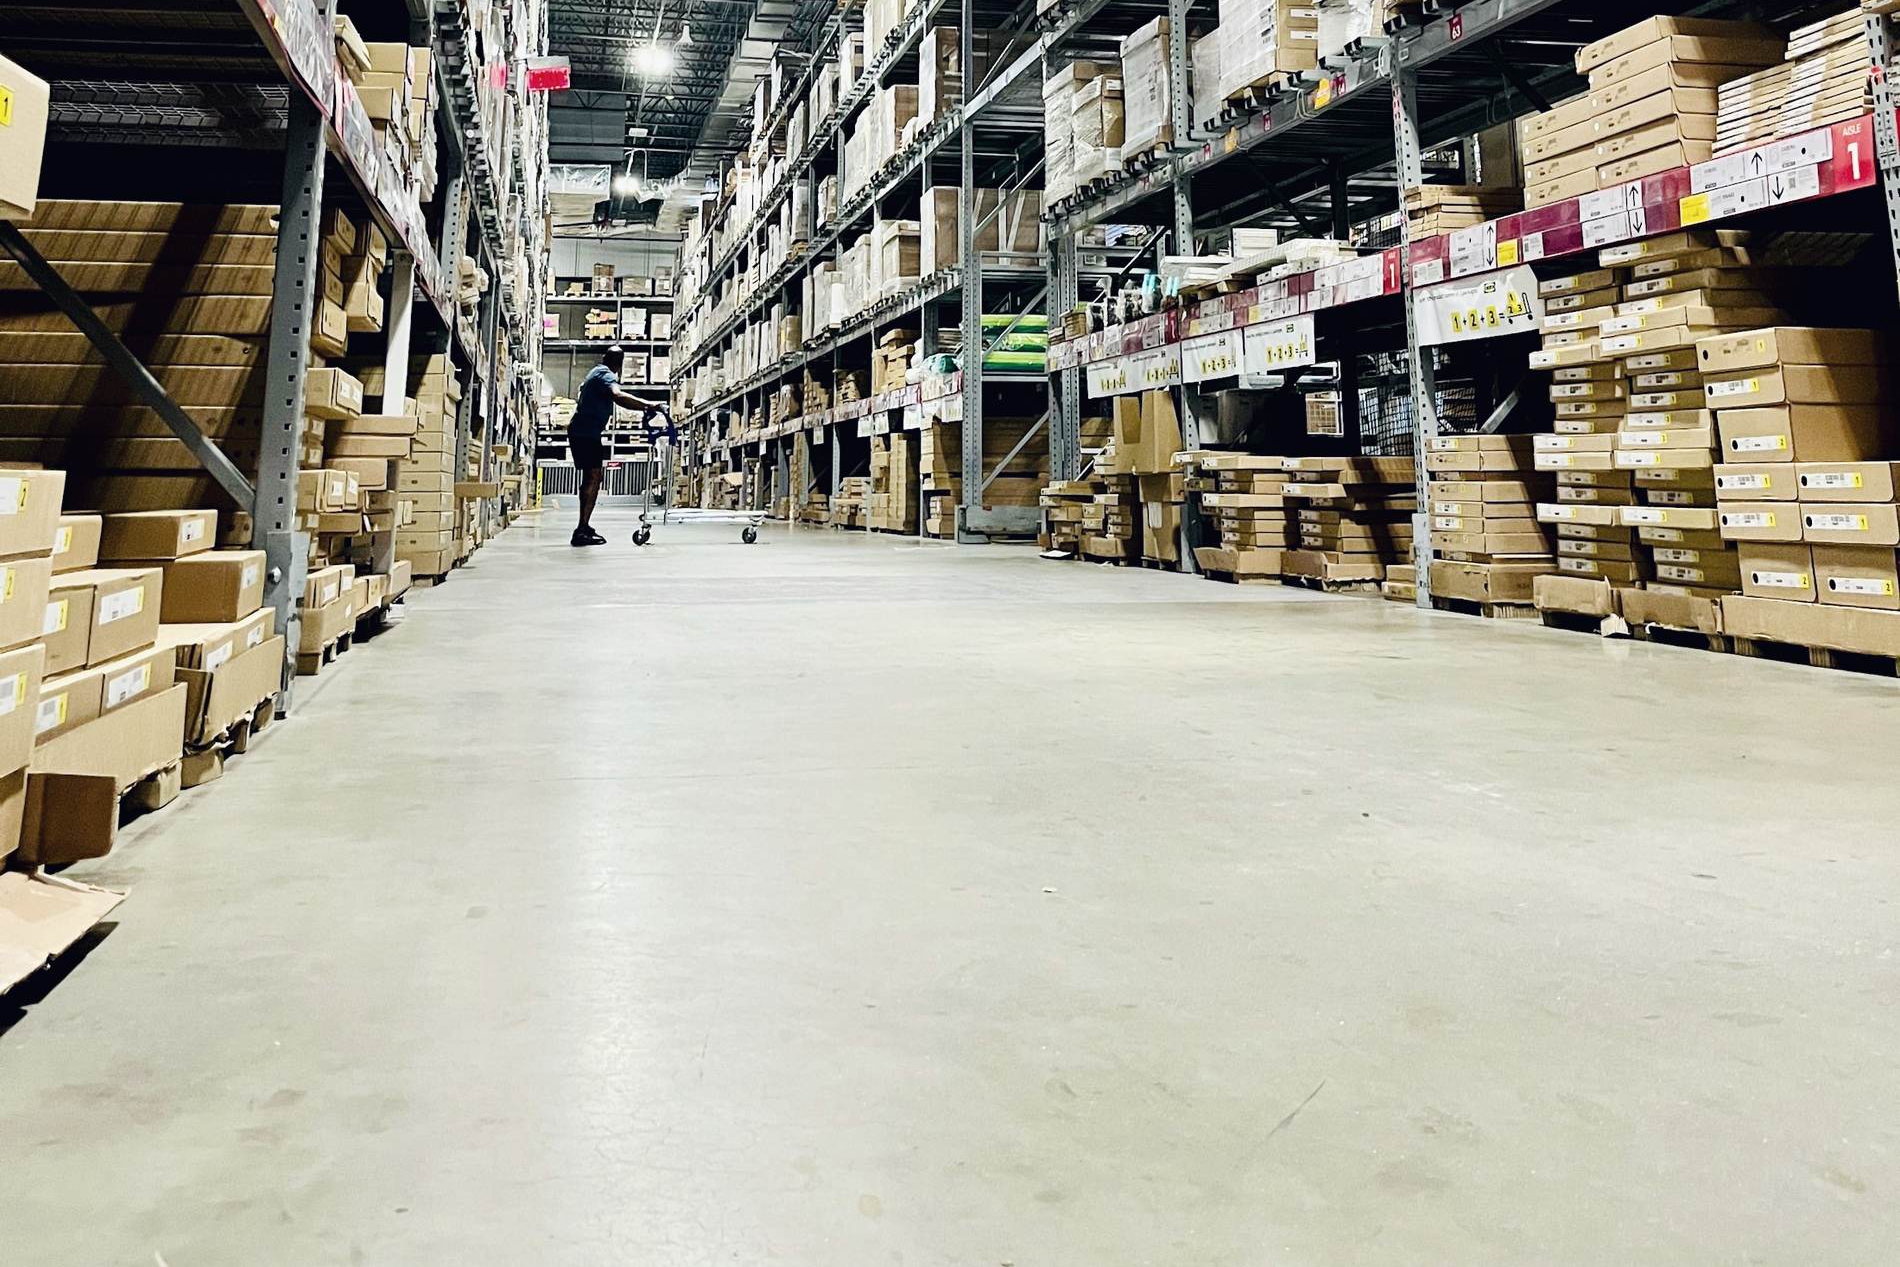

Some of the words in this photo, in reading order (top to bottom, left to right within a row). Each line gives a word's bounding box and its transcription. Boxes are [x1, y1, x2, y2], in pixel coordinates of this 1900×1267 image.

[1842, 123, 1862, 136] AISLE
[1847, 141, 1861, 181] 1
[1389, 262, 1395, 289] 1
